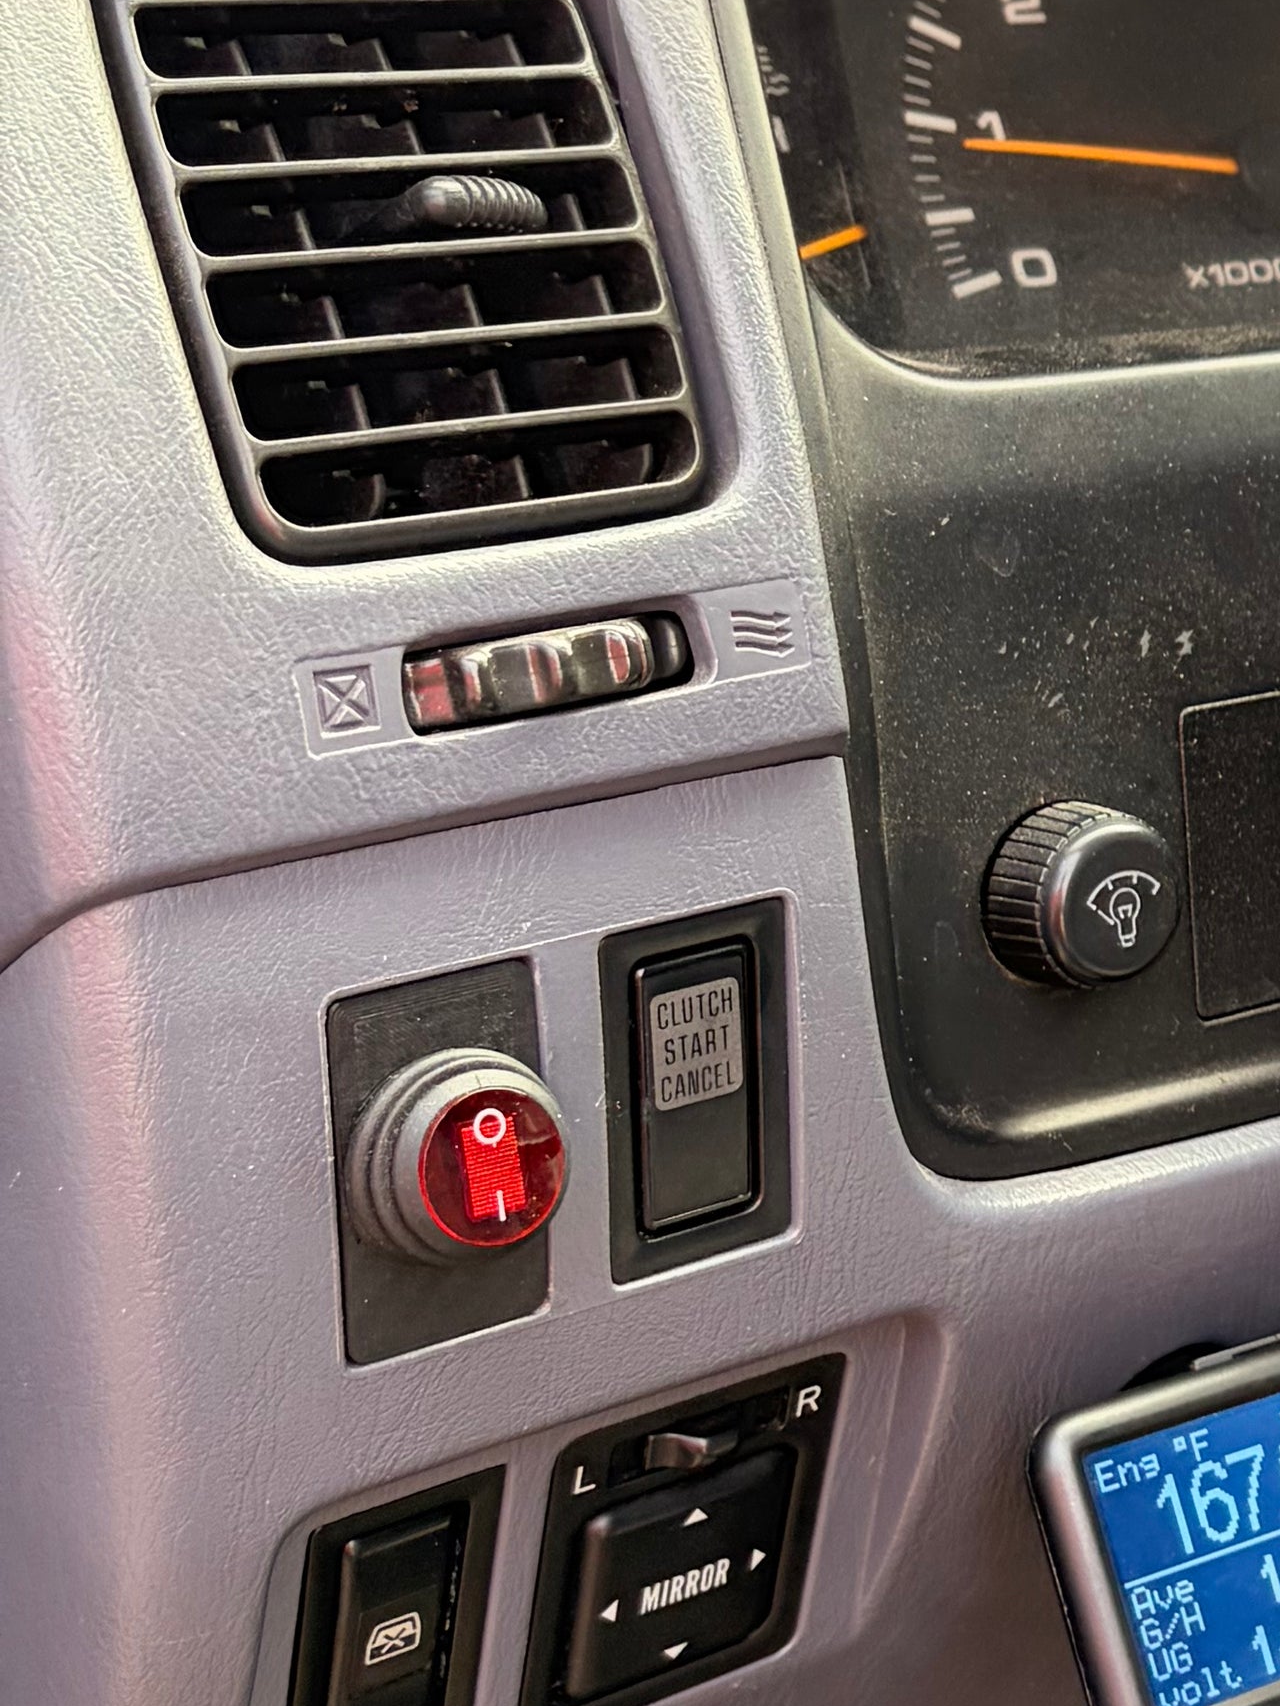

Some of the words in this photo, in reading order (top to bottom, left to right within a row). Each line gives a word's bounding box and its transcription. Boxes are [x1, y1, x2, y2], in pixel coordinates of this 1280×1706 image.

[976, 110, 1006, 140] 1
[1010, 247, 1058, 287] 0
[657, 986, 733, 1030] CLUTCH
[664, 1024, 729, 1066] START
[661, 1060, 735, 1103] CANCEL
[795, 1385, 821, 1418] R
[573, 1466, 596, 1495] L
[1094, 1453, 1161, 1495] Eng
[640, 1558, 730, 1615] MIRROR
[1131, 1579, 1195, 1620] Ave
[1140, 1601, 1206, 1650] G/H
[1148, 1641, 1194, 1682] UG
